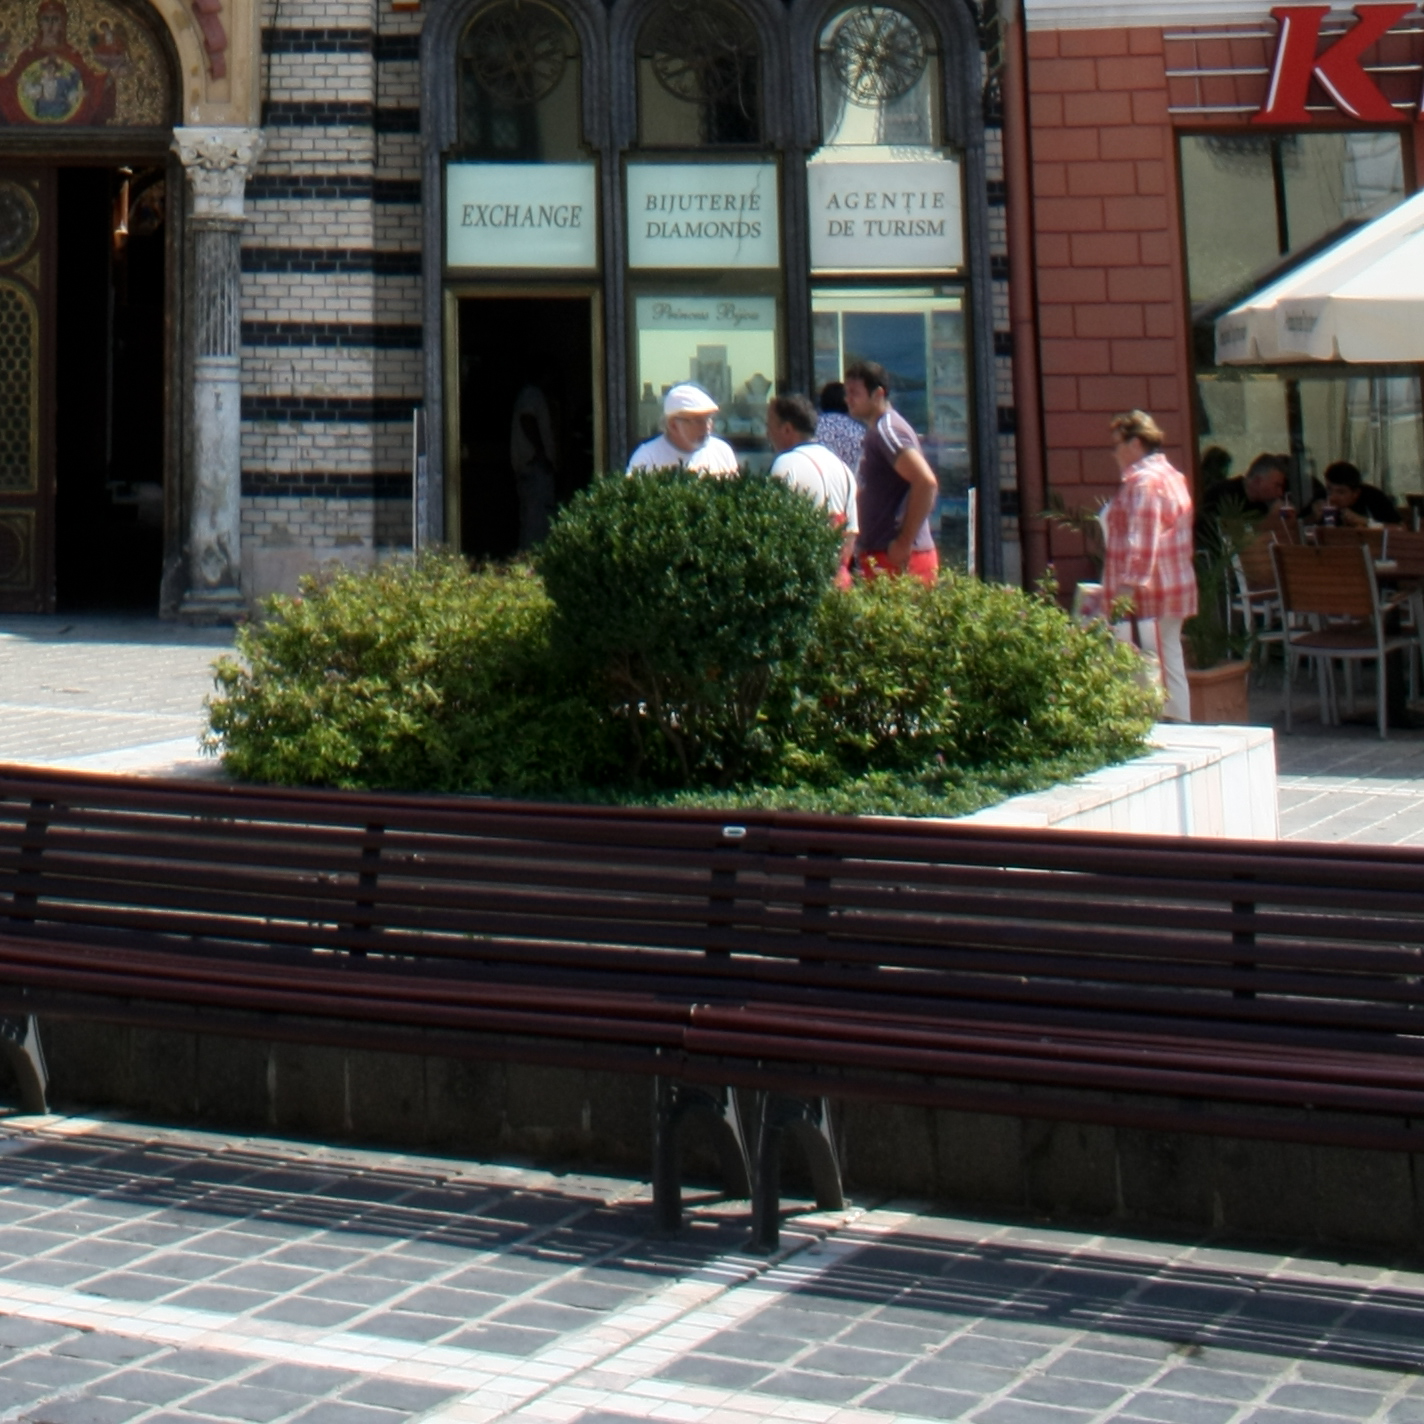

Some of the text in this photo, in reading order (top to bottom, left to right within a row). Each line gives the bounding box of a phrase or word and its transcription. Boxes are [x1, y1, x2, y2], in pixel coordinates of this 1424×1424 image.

[1251, 3, 1424, 124] K
[645, 193, 762, 213] BIJUTERIE
[460, 204, 583, 229] EXCHANGE
[645, 221, 762, 240] DIAMONDS
[827, 219, 946, 237] DE TURISM
